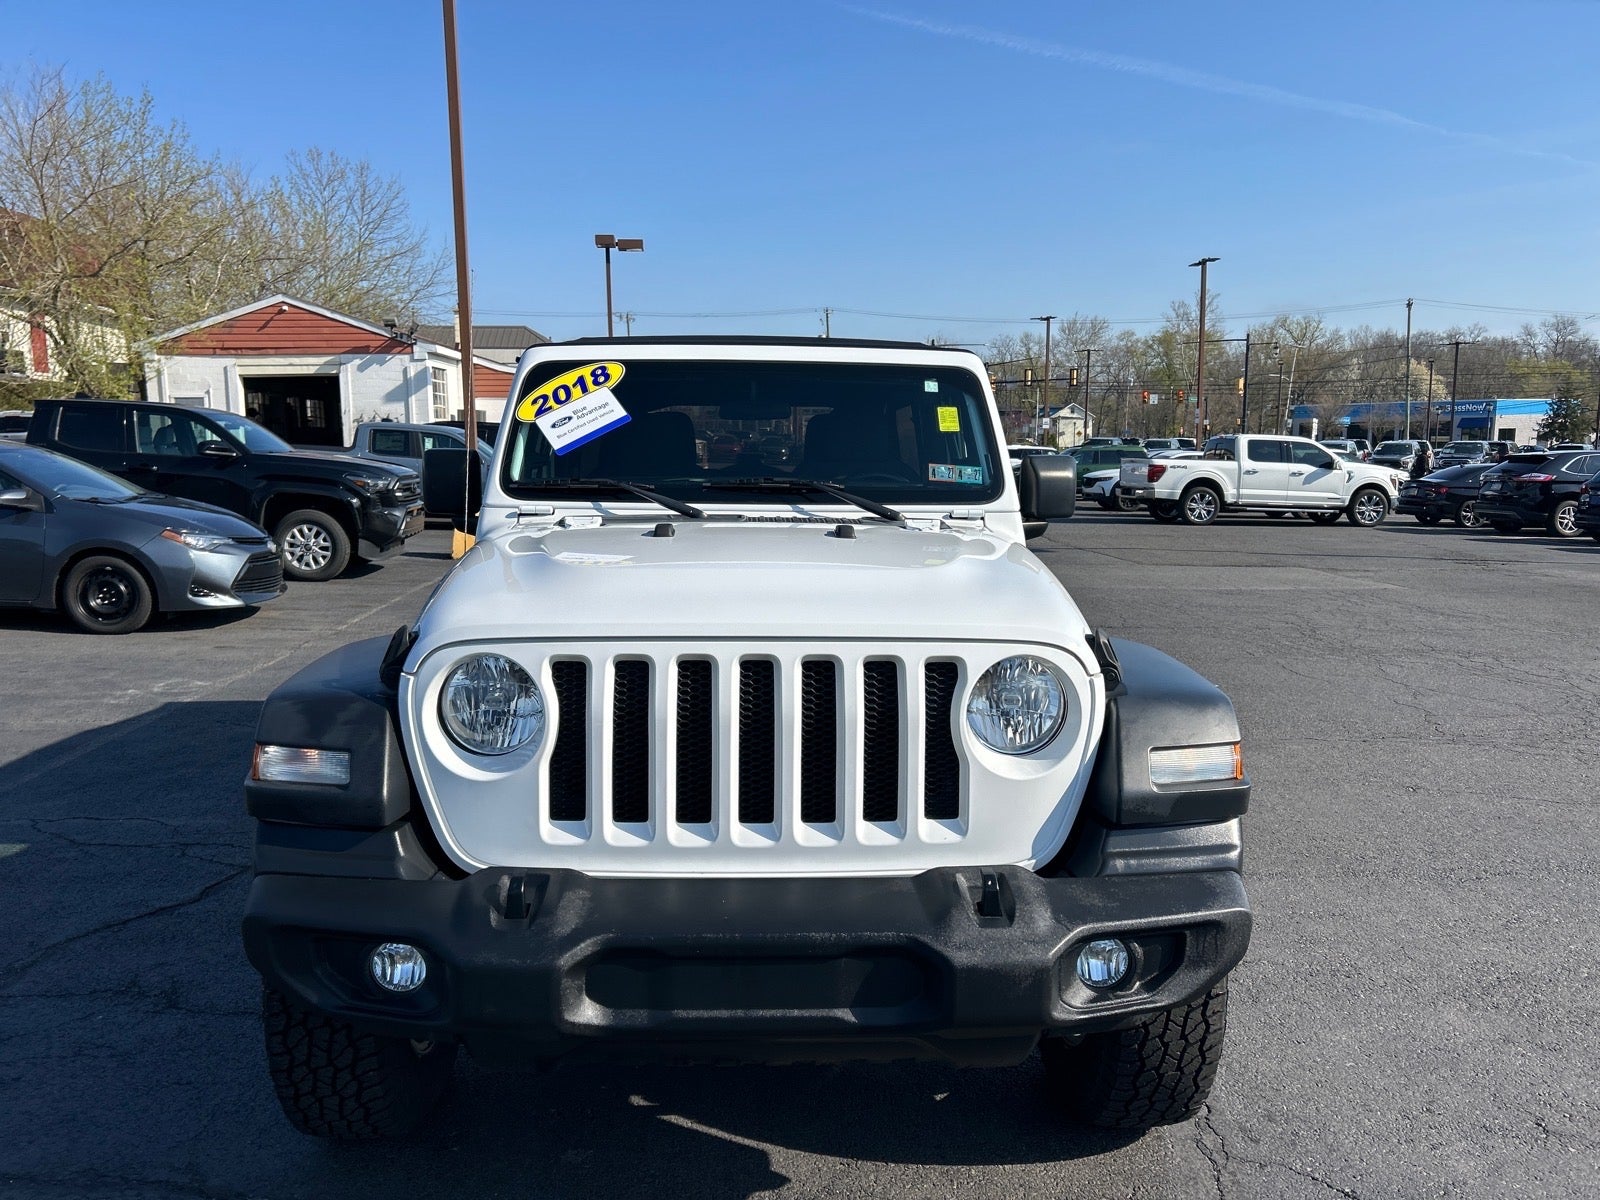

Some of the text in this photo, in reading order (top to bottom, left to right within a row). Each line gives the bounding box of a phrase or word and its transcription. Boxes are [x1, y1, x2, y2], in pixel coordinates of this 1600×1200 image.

[531, 365, 611, 418] 2018
[572, 406, 587, 416] Blue
[576, 401, 609, 420] Advantage
[553, 416, 571, 428] Ford
[567, 422, 587, 433] Certified
